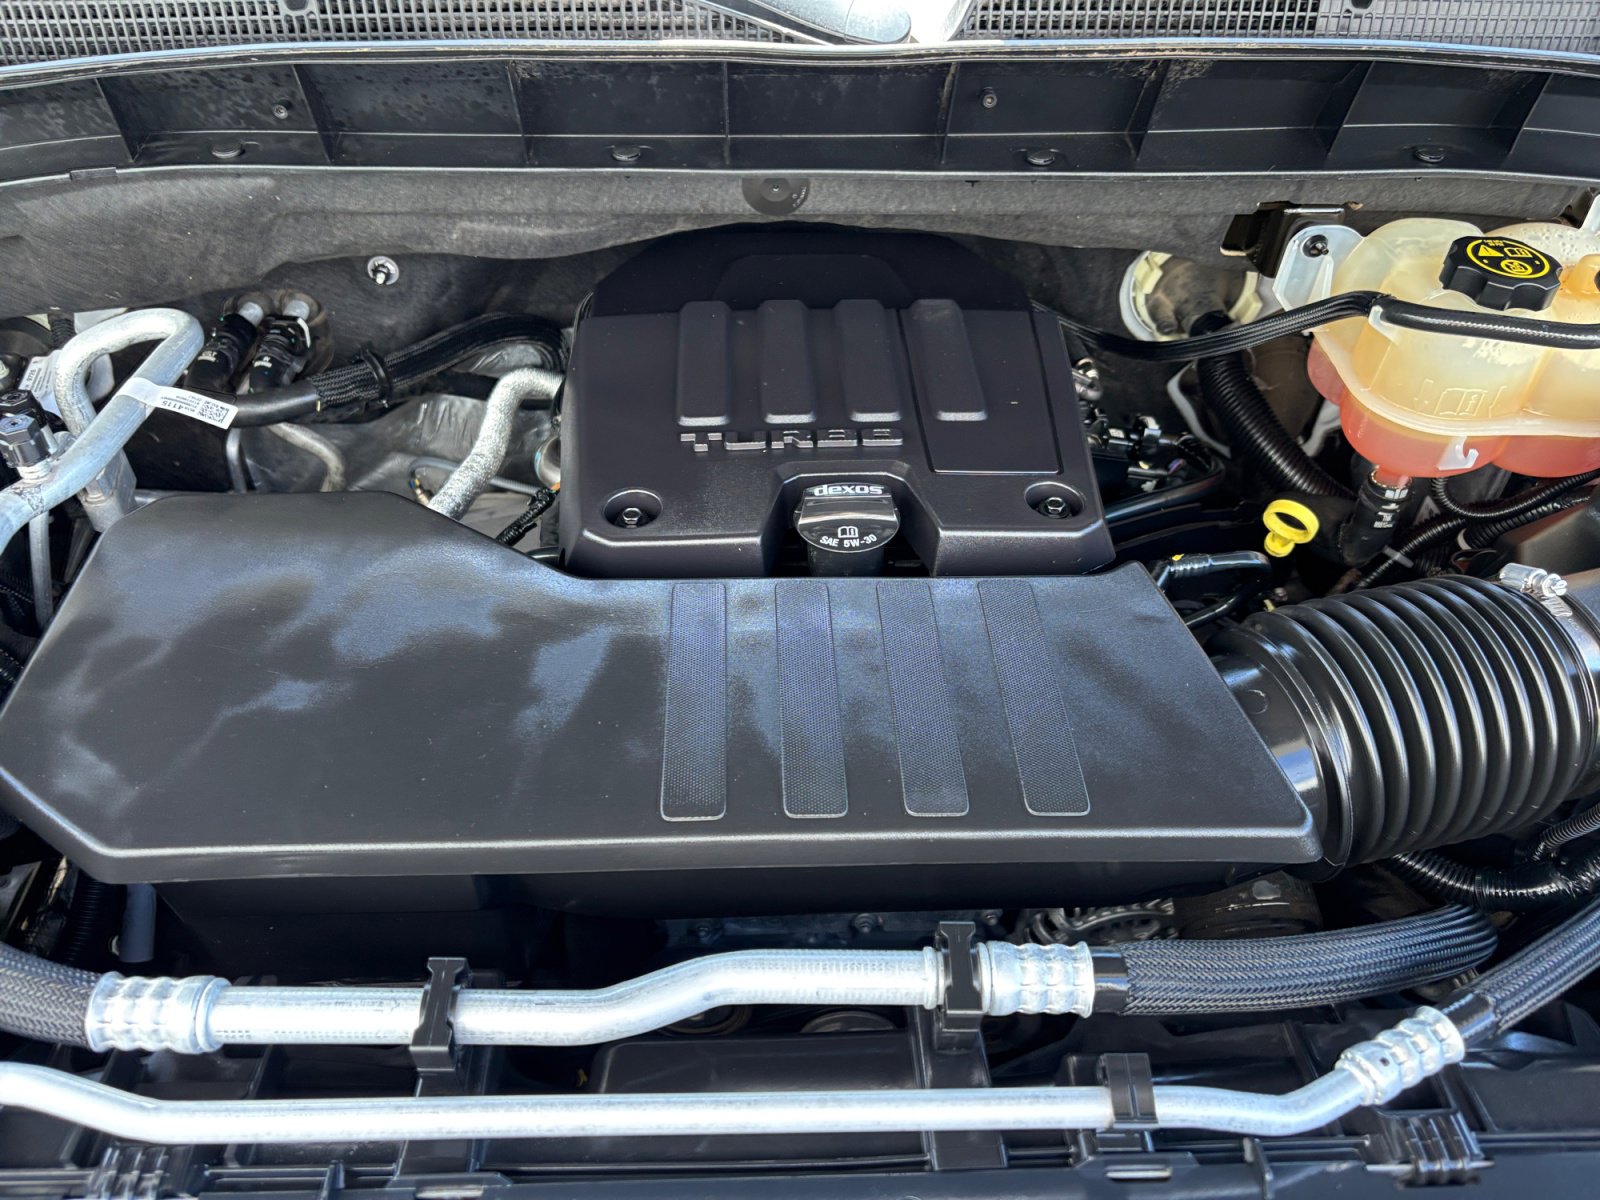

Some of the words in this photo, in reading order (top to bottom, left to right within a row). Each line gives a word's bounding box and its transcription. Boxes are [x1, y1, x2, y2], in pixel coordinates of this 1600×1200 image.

[813, 484, 885, 496] dexos
[820, 535, 839, 547] SAE
[843, 534, 877, 547] 5W-30
